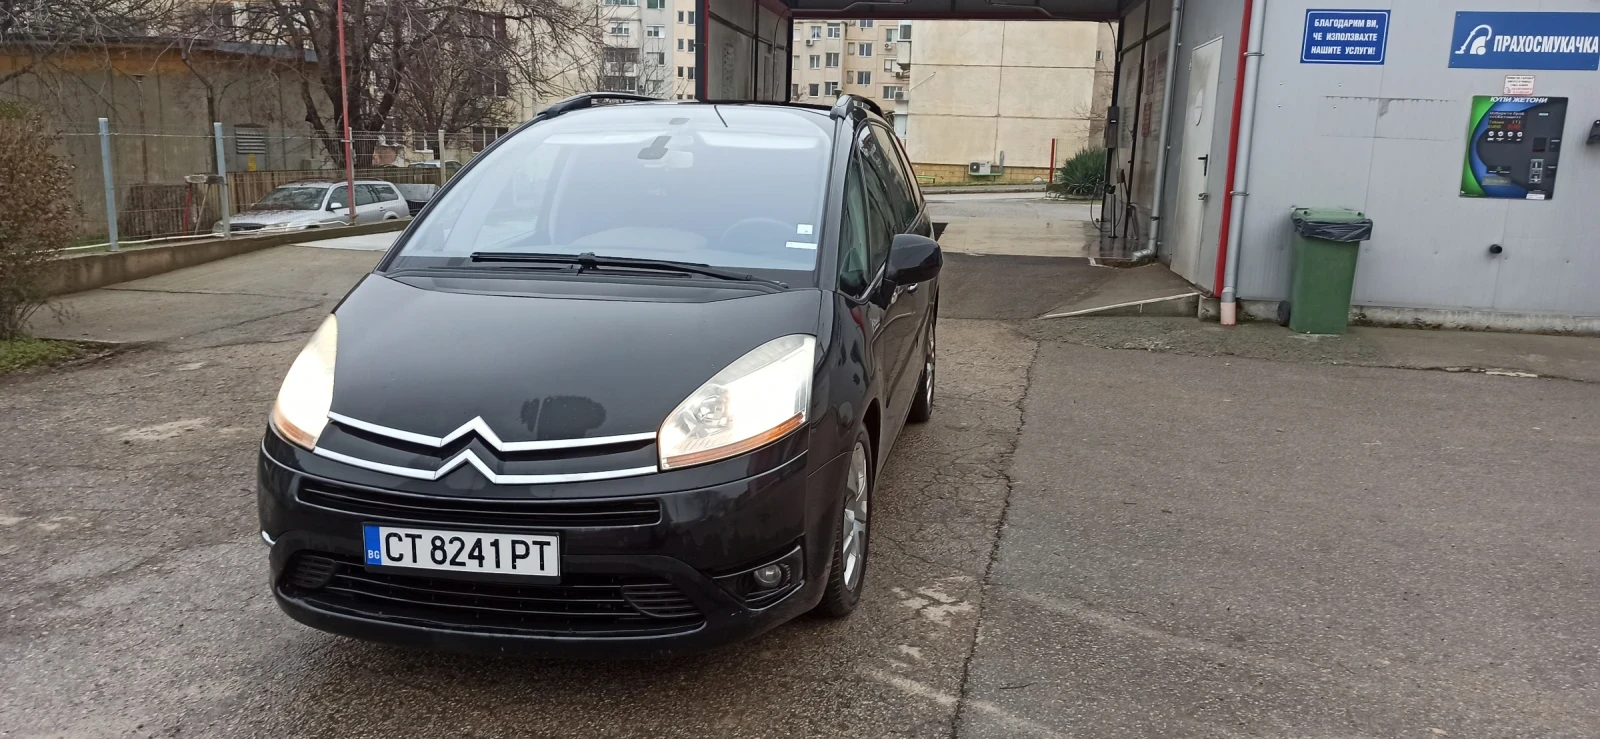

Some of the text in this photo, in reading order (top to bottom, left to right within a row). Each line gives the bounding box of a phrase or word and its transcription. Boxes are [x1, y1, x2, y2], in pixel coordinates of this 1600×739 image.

[1314, 18, 1379, 29] БЛАГОДАРИМ ВИ,
[1313, 32, 1378, 41] ЧЕ ИЗПОЛЗВАХТЕ
[1493, 35, 1599, 53] ПРАХОСМУКАЧКА
[1311, 45, 1376, 55] НАШИТЕ УСЛУГИ!
[368, 550, 380, 559] BG
[385, 532, 551, 571] CT 8241 PT
